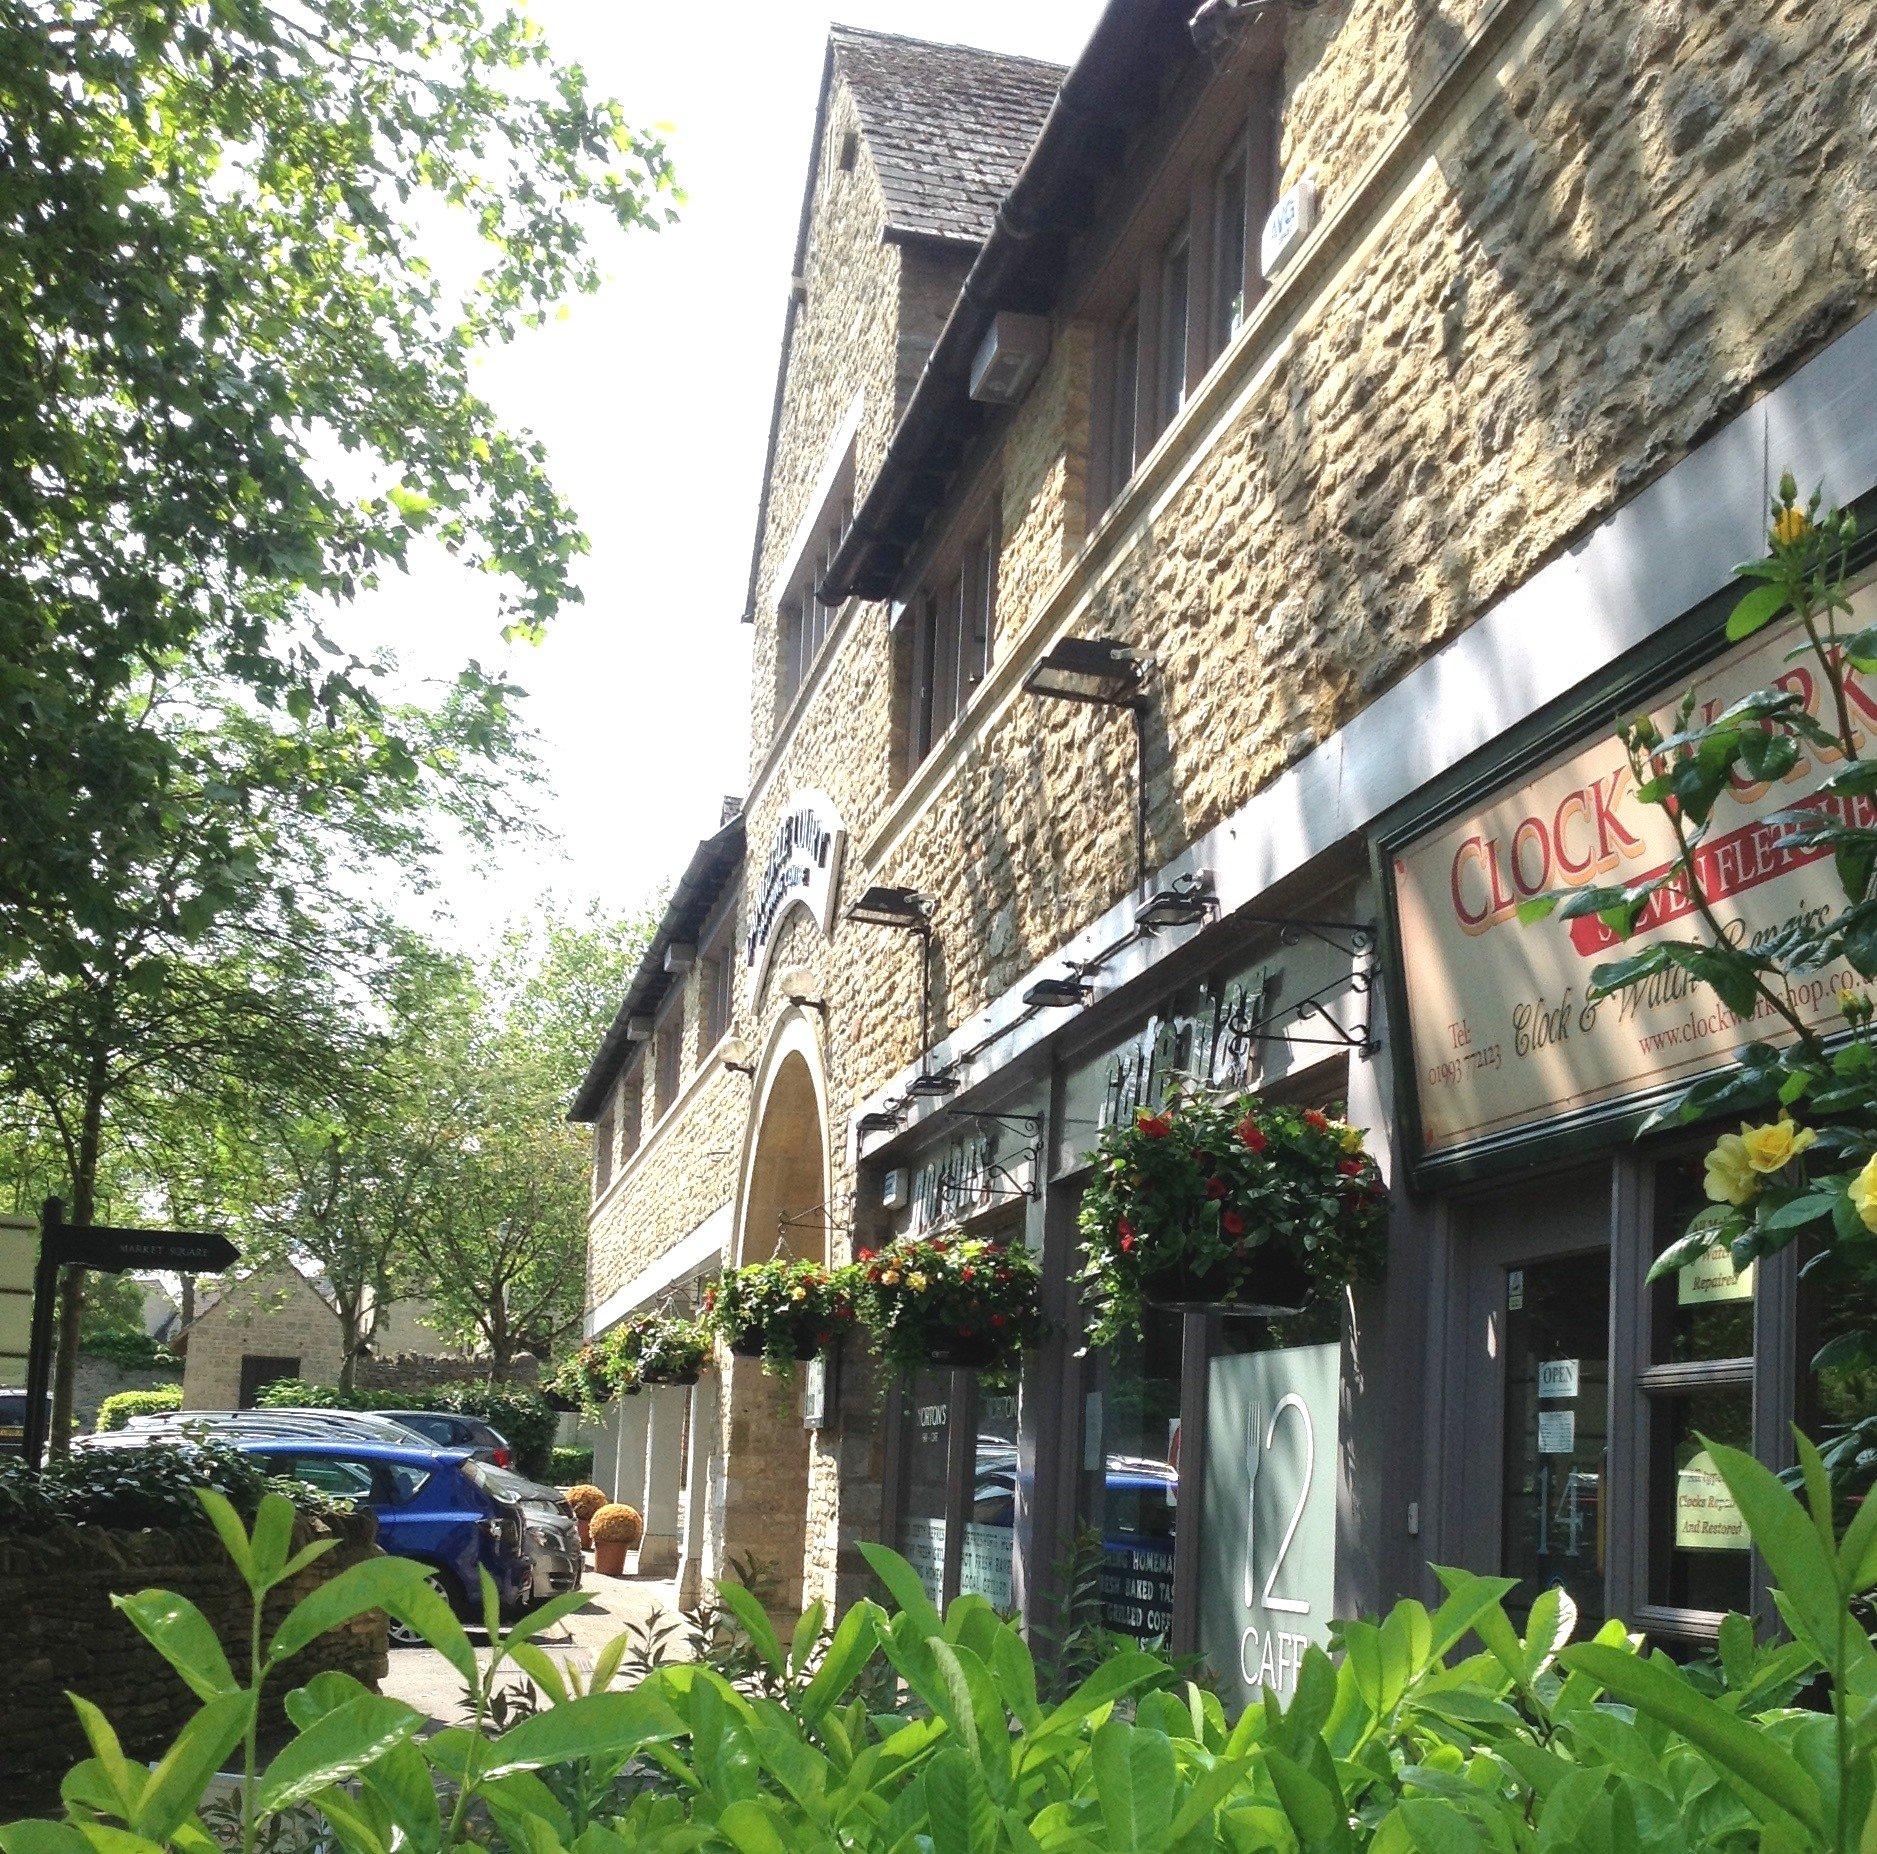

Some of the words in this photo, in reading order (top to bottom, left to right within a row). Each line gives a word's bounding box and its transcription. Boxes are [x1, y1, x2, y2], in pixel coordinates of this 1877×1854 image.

[1451, 764, 1643, 930] CLOCK
[1512, 987, 1574, 1060] Clock
[119, 1244, 162, 1255] MARKET
[1543, 1366, 1573, 1384] OPEN
